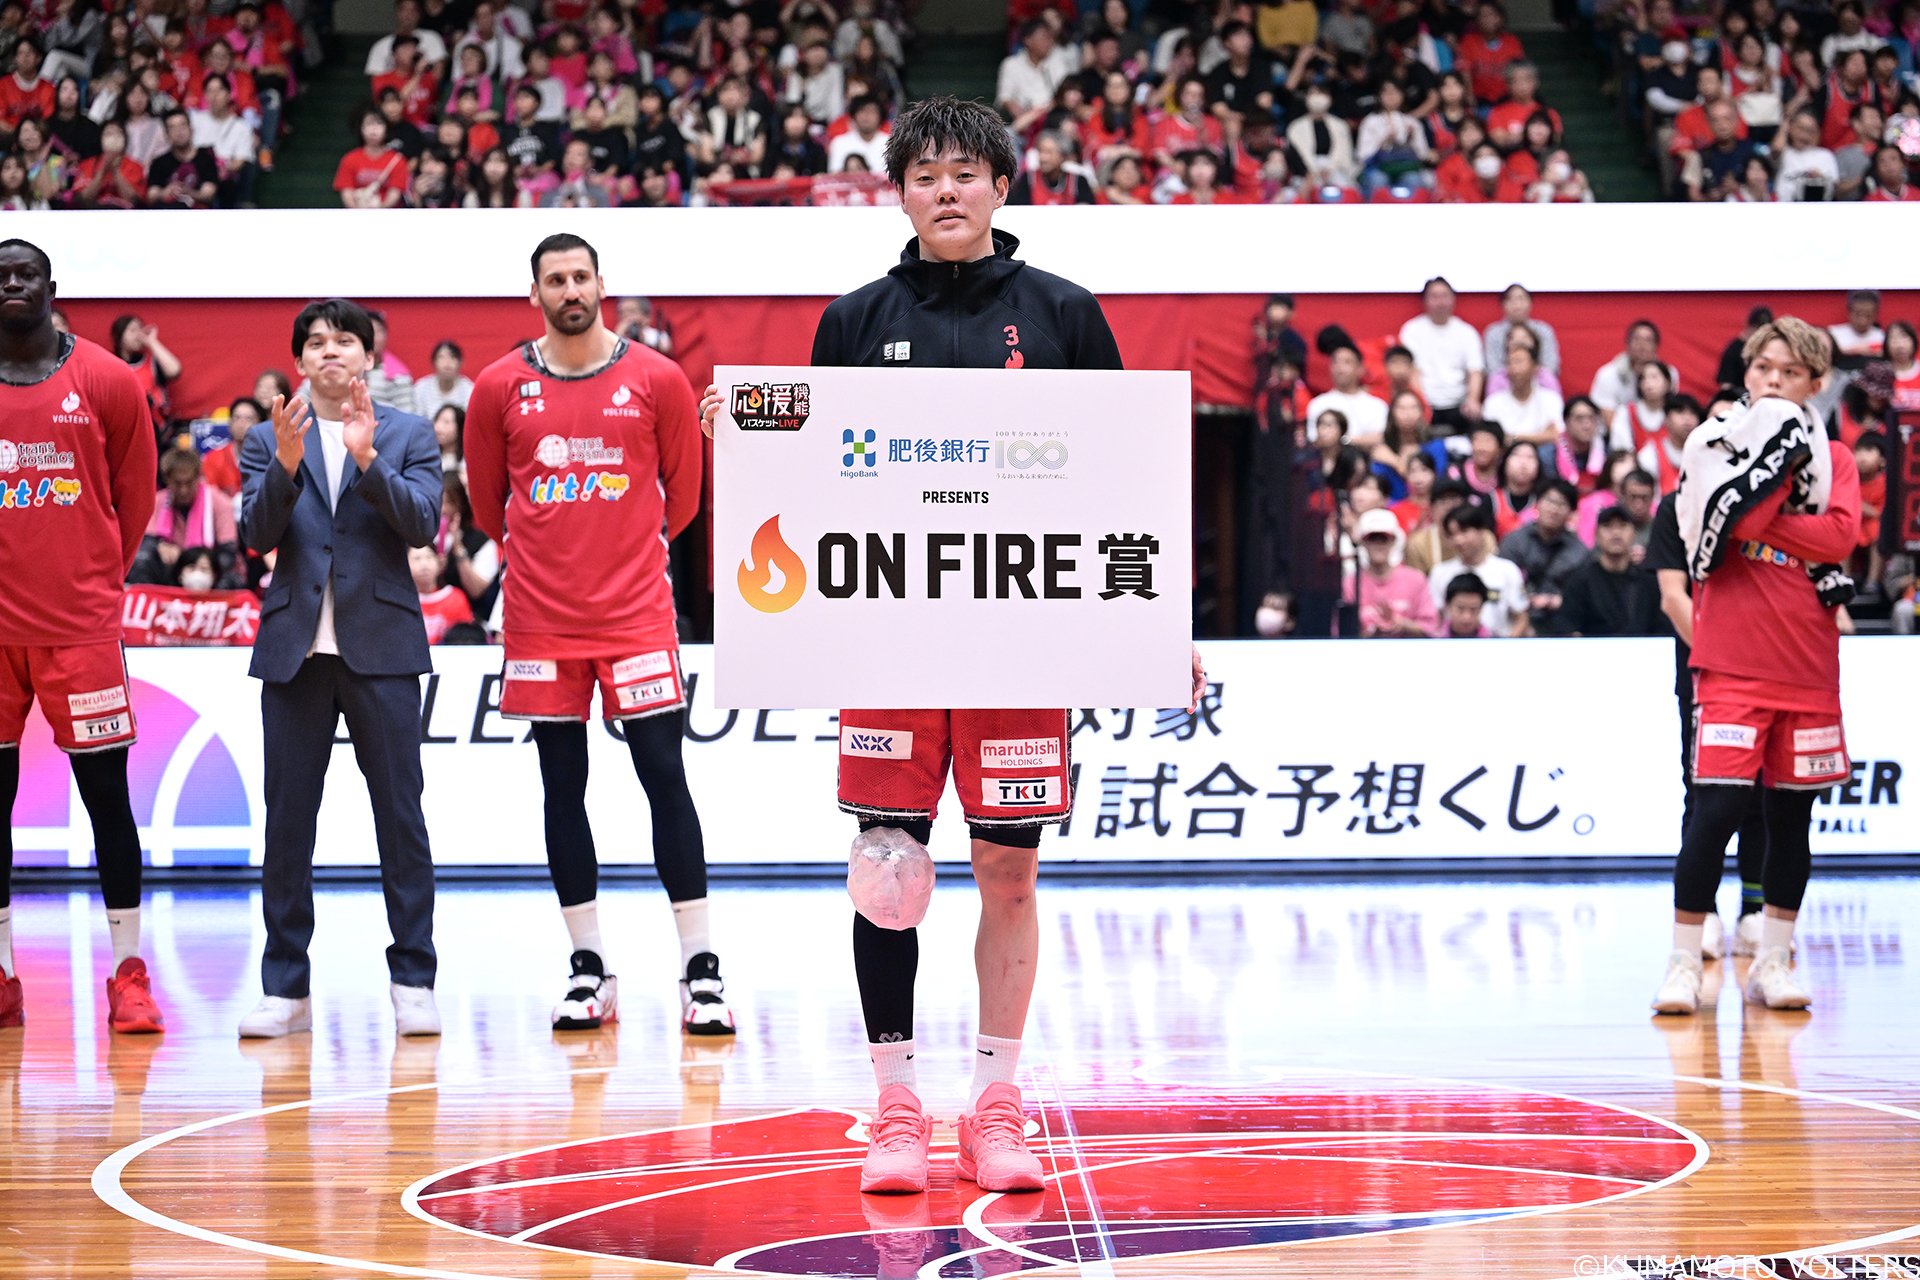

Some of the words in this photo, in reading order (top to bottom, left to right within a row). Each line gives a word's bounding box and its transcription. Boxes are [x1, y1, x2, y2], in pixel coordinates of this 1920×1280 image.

[1003, 324, 1020, 346] 3
[52, 414, 89, 424] VOLTERS
[603, 407, 640, 418] VOLTERS
[19, 442, 55, 455] trans
[888, 438, 990, 463] 肥後銀行
[19, 452, 75, 467] cosmos
[840, 470, 879, 479] HigoBank
[922, 491, 990, 504] PRESENTS
[1695, 487, 1742, 580] NDER
[818, 533, 905, 598] ON
[927, 533, 1081, 599] FIRE
[1097, 533, 1160, 600] 賞
[121, 593, 260, 638] 山本翔太
[630, 686, 663, 700] TKU
[86, 721, 120, 734] TKU
[851, 733, 893, 752] NOK
[983, 739, 1058, 757] marubishi
[1000, 758, 1043, 766] HOLDINGS
[1808, 759, 1836, 771] TKU
[998, 785, 1046, 799] TKU
